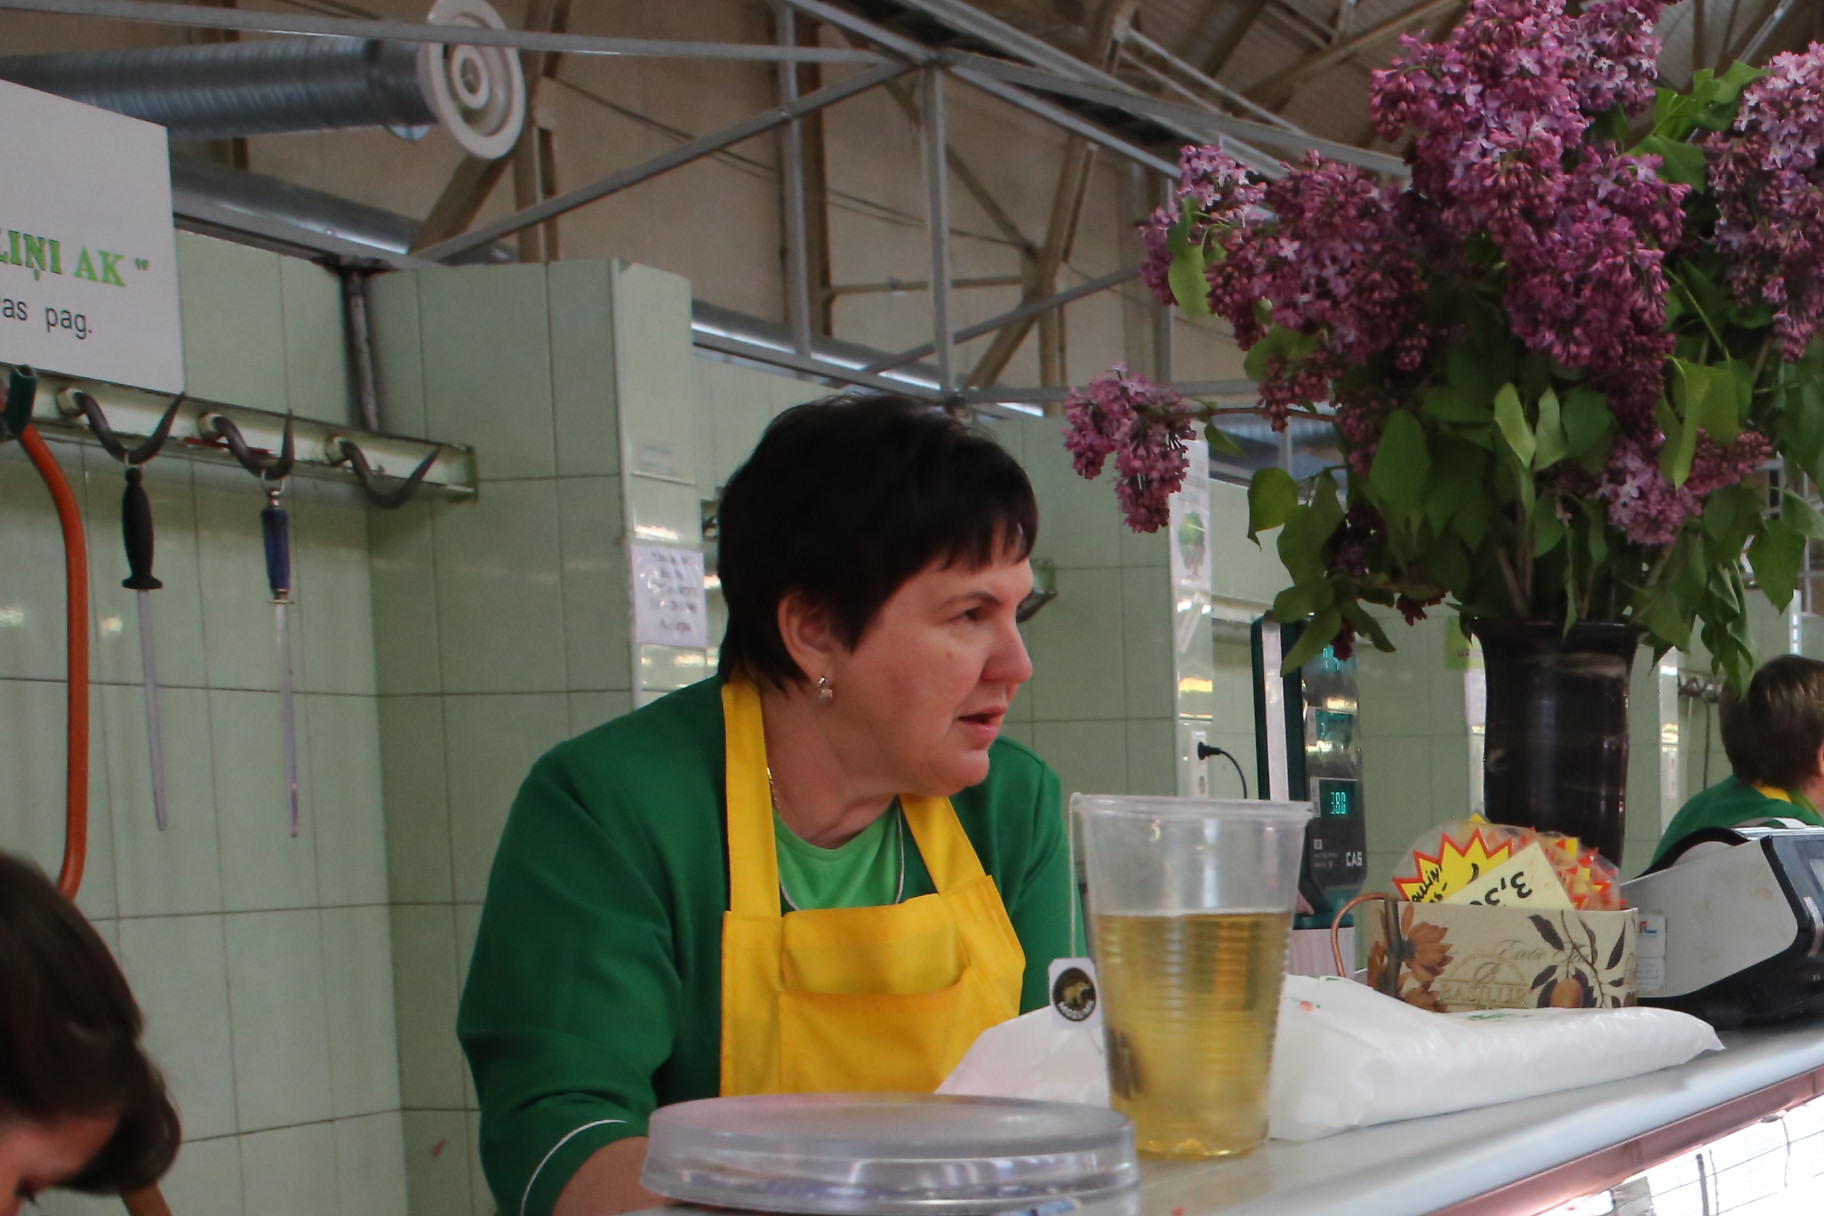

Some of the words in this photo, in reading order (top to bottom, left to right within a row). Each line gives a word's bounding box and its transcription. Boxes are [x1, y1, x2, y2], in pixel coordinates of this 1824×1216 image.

[0, 298, 28, 321] as
[45, 307, 92, 340] pag.
[1346, 851, 1363, 867] CAS
